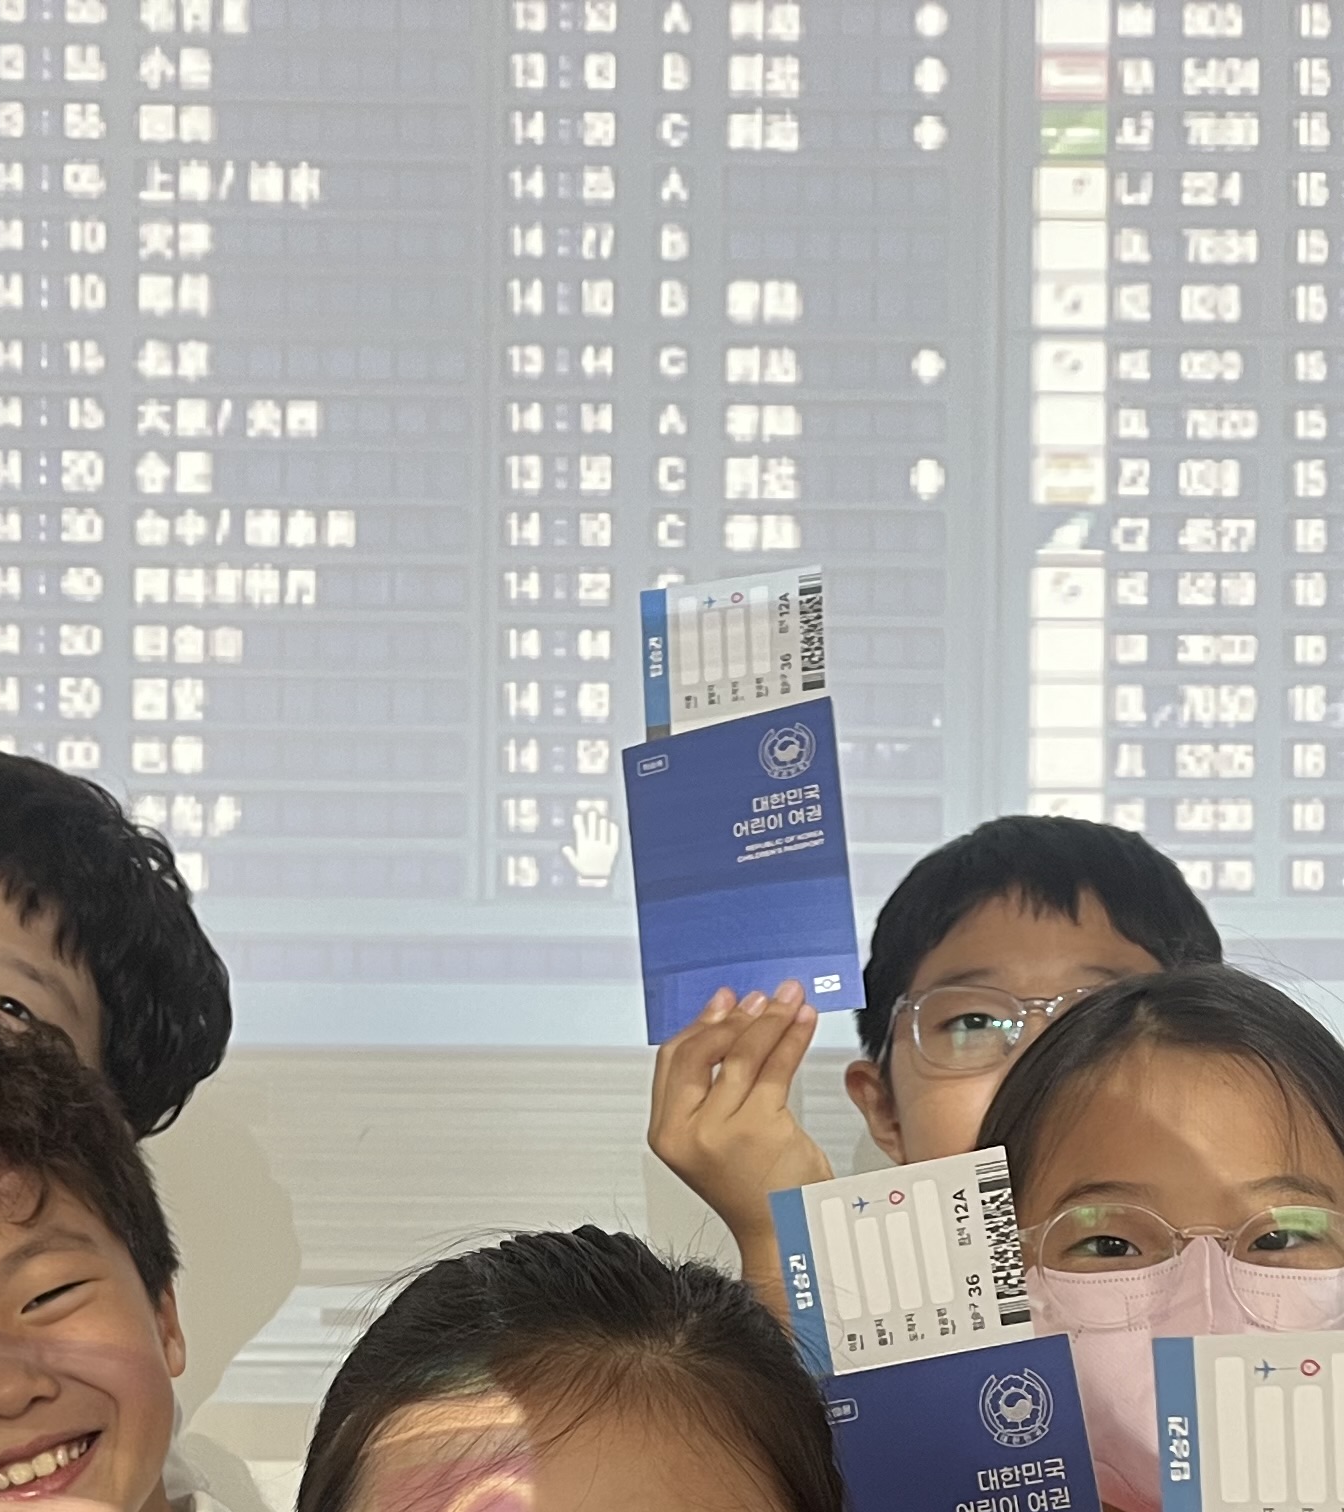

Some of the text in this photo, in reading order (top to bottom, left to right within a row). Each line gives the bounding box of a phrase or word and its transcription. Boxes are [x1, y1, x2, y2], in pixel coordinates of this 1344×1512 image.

[752, 784, 820, 813] 대한민국
[733, 804, 822, 837] 어린이 여권
[952, 1188, 969, 1223] 12A
[966, 1274, 982, 1297] 36
[977, 1457, 1066, 1491] 대한민국
[1027, 1486, 1072, 1512] 여권
